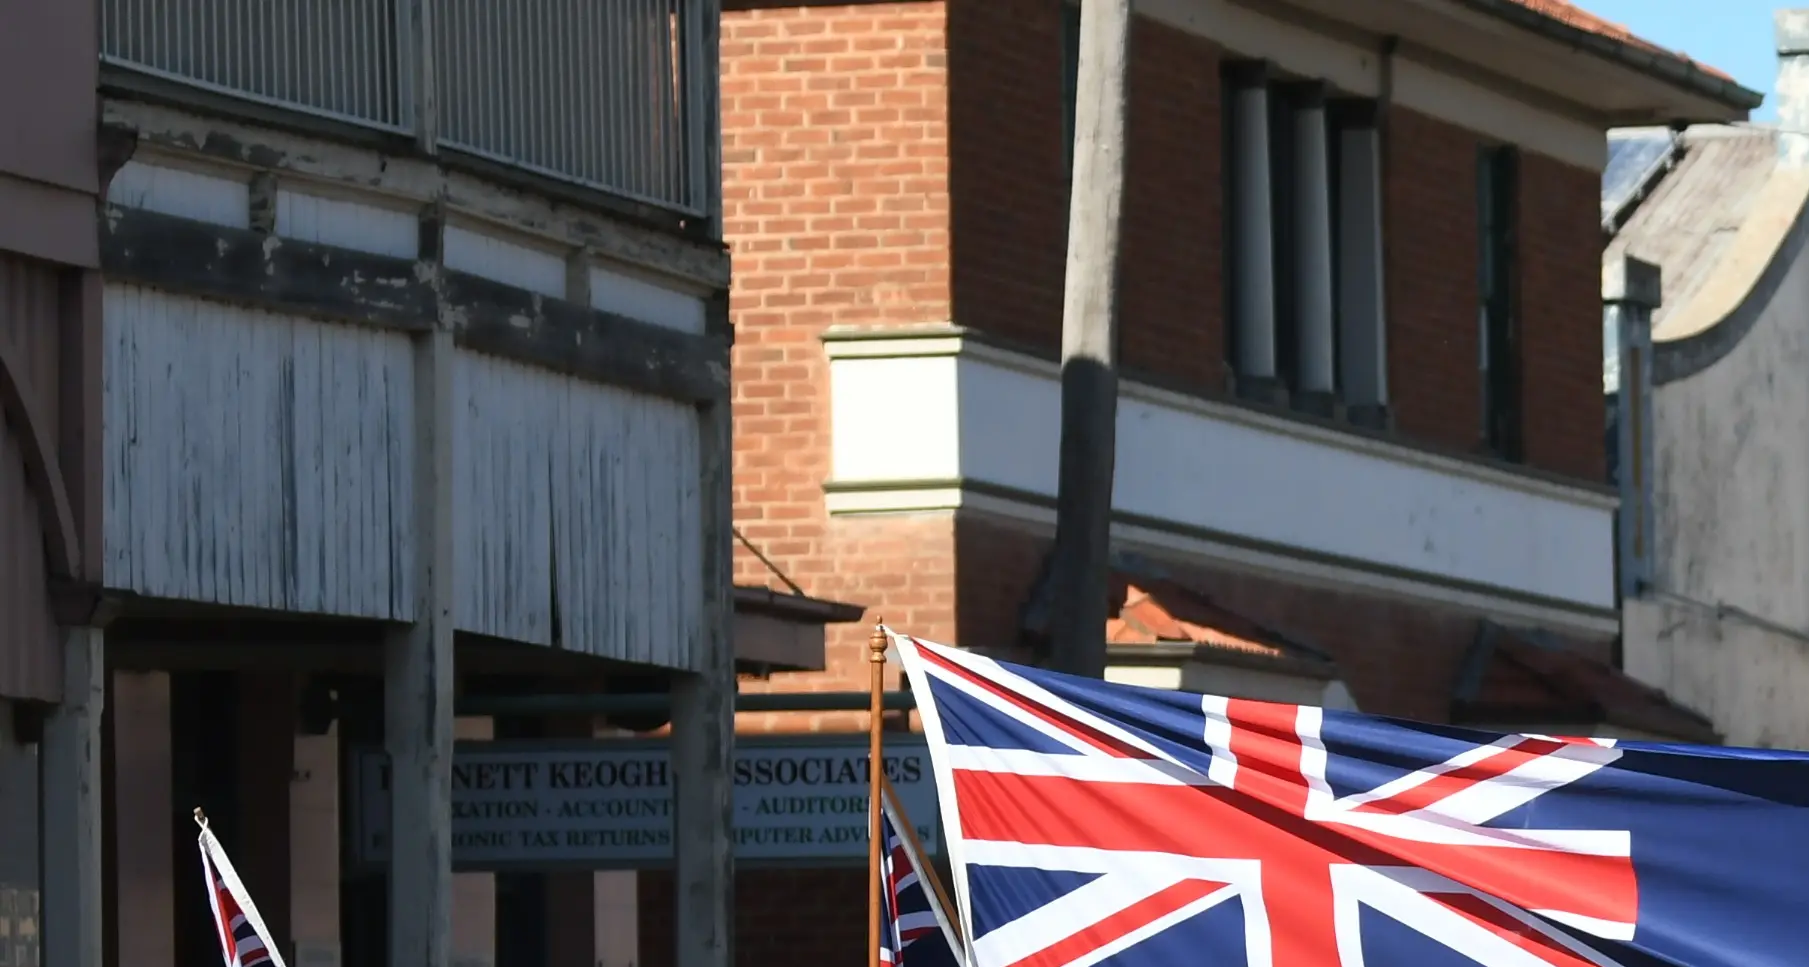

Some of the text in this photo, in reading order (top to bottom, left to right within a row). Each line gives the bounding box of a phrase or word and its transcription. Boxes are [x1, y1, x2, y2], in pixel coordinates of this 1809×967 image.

[379, 755, 921, 790] NETT KEOGH SSOCIATES
[452, 799, 539, 818] XATION
[557, 799, 673, 818] ACCOUNT
[755, 796, 869, 816] AUDITOR
[520, 829, 558, 848] TAX
[566, 828, 670, 848] RETURNS
[733, 826, 813, 845] PUTER
